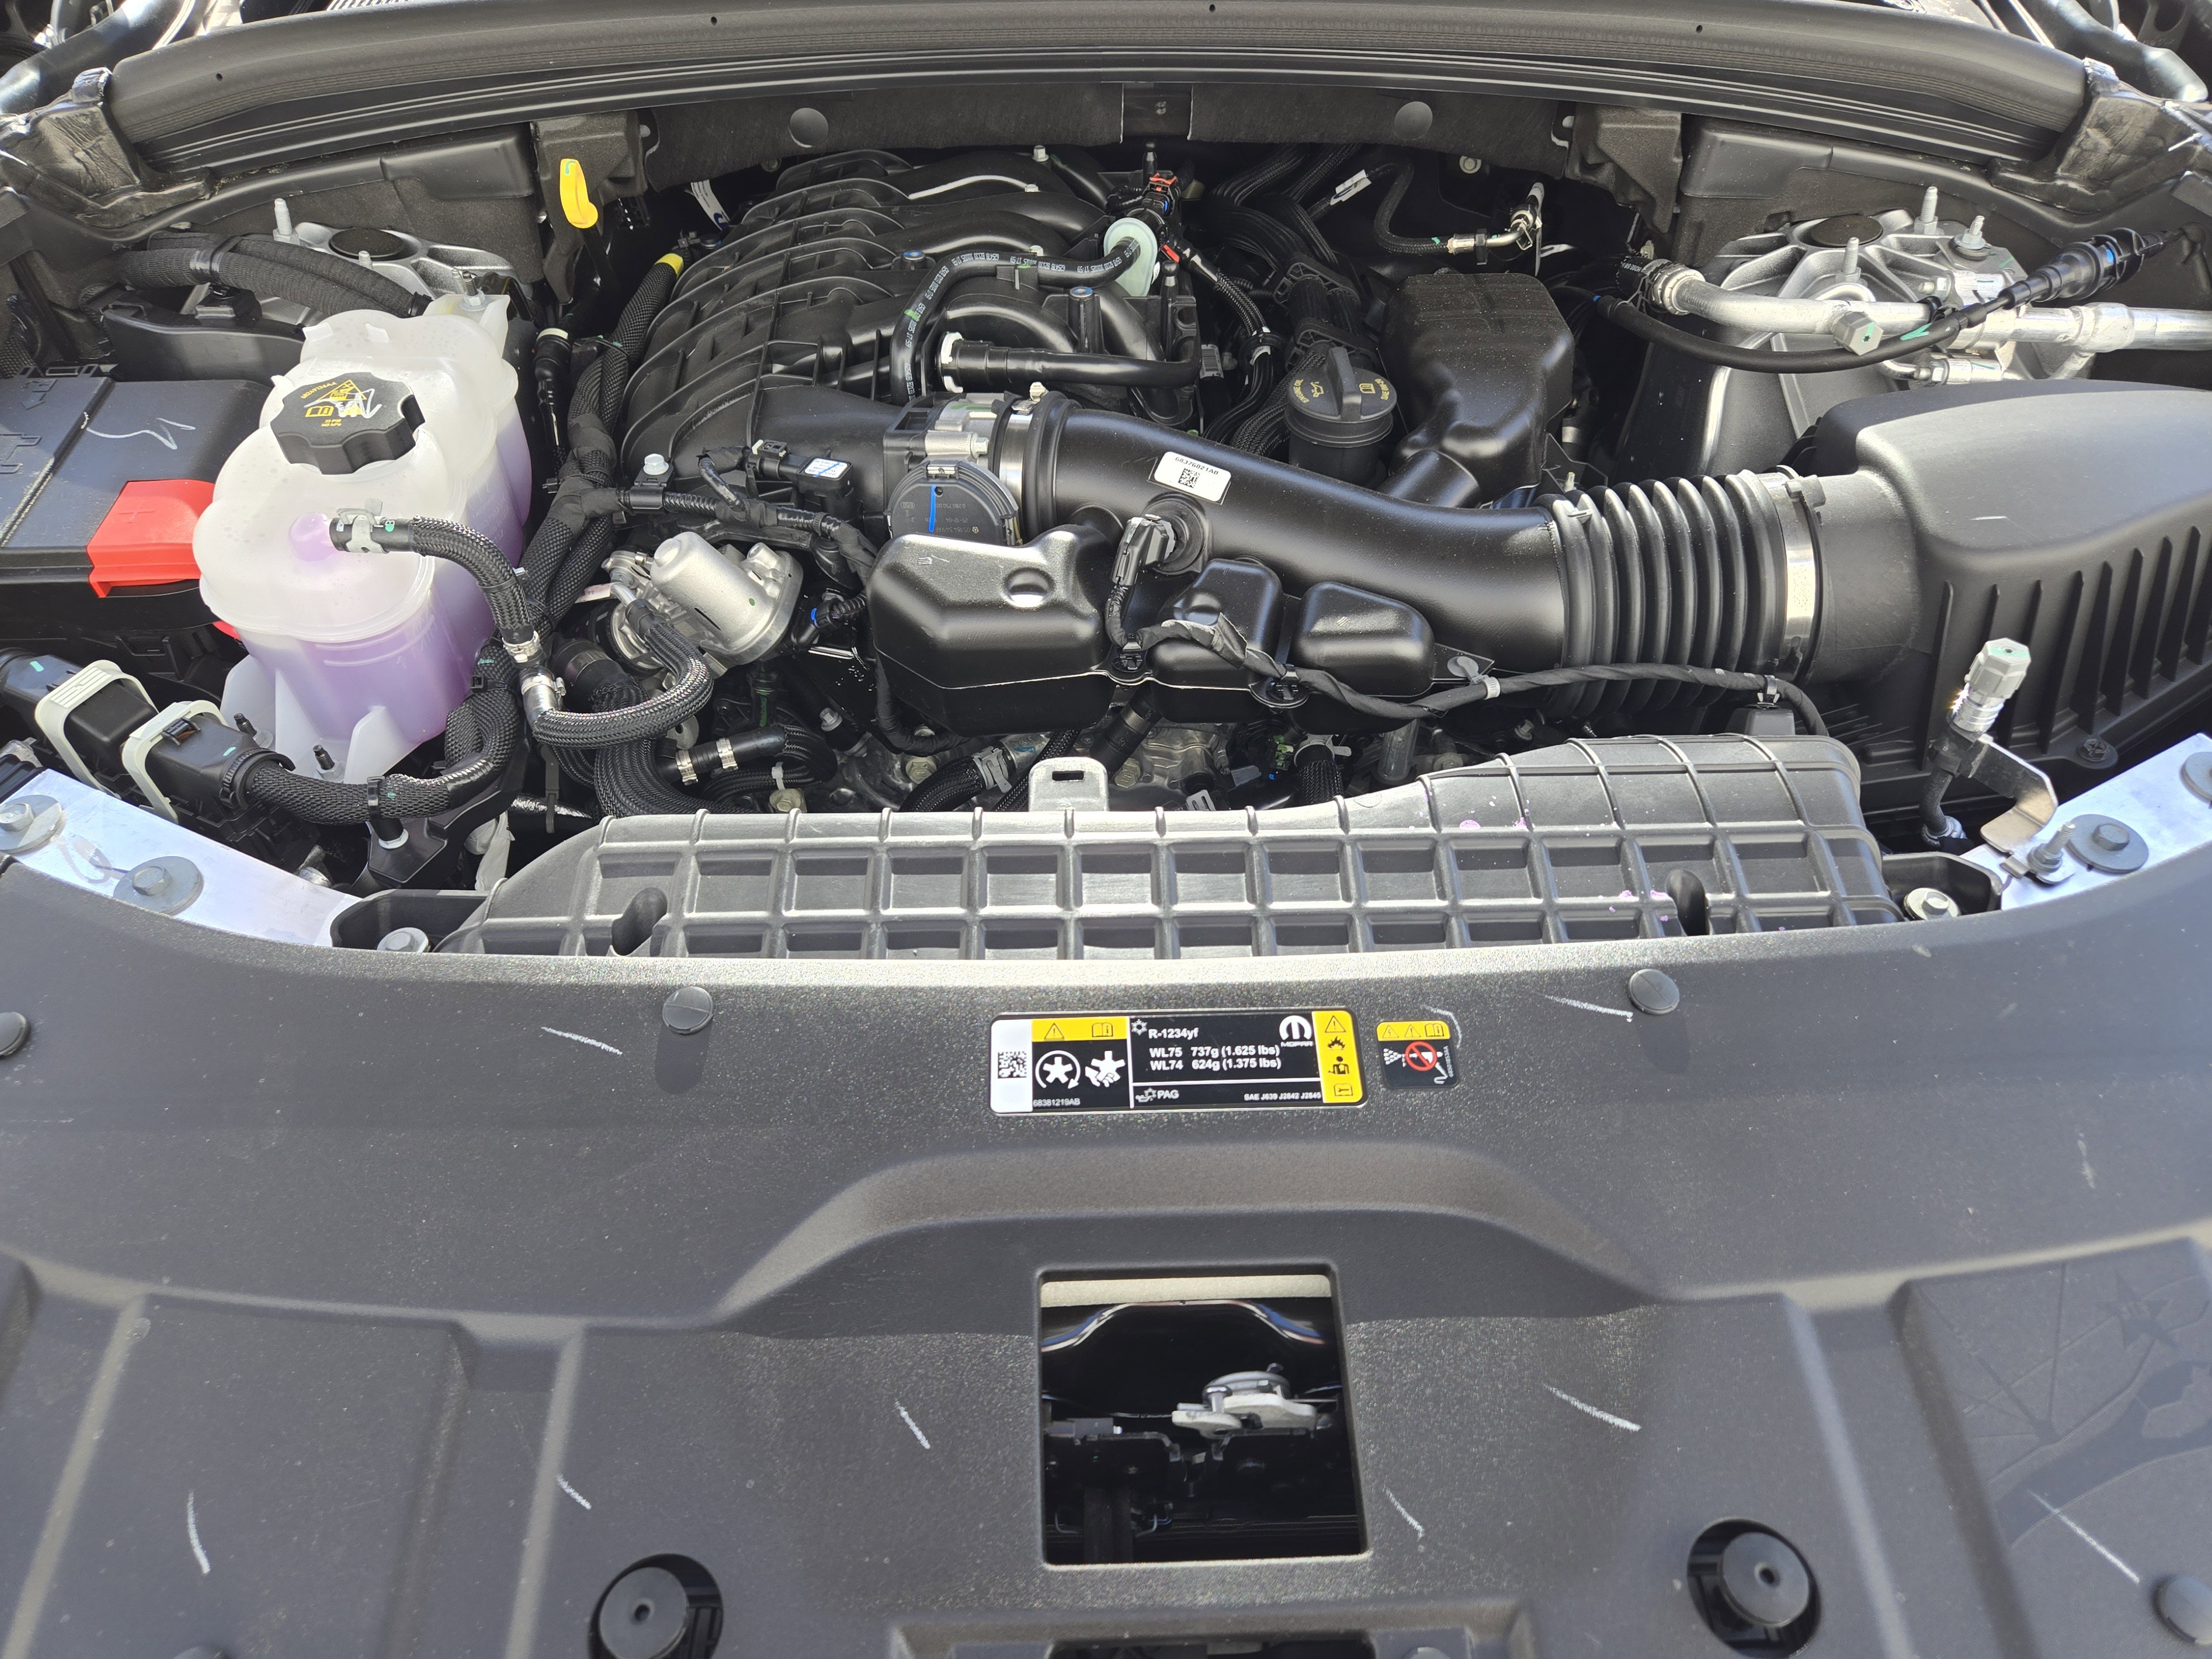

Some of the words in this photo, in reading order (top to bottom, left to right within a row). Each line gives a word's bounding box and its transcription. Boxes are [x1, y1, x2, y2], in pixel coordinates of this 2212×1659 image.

[1293, 387, 1310, 404] ENGINE
[1148, 1027, 1199, 1040] R-1234yf
[1149, 1047, 1183, 1058] WL75
[1190, 1046, 1219, 1058] 737g
[1221, 1045, 1256, 1058] (1.625
[1258, 1045, 1280, 1056] lbs)
[1150, 1060, 1183, 1071] WL74
[1192, 1058, 1220, 1071] 624g
[1222, 1058, 1258, 1071] (1.375
[1259, 1057, 1281, 1070] lbs)
[1157, 1089, 1180, 1099] PAG
[1033, 1098, 1081, 1107] 68381219AB
